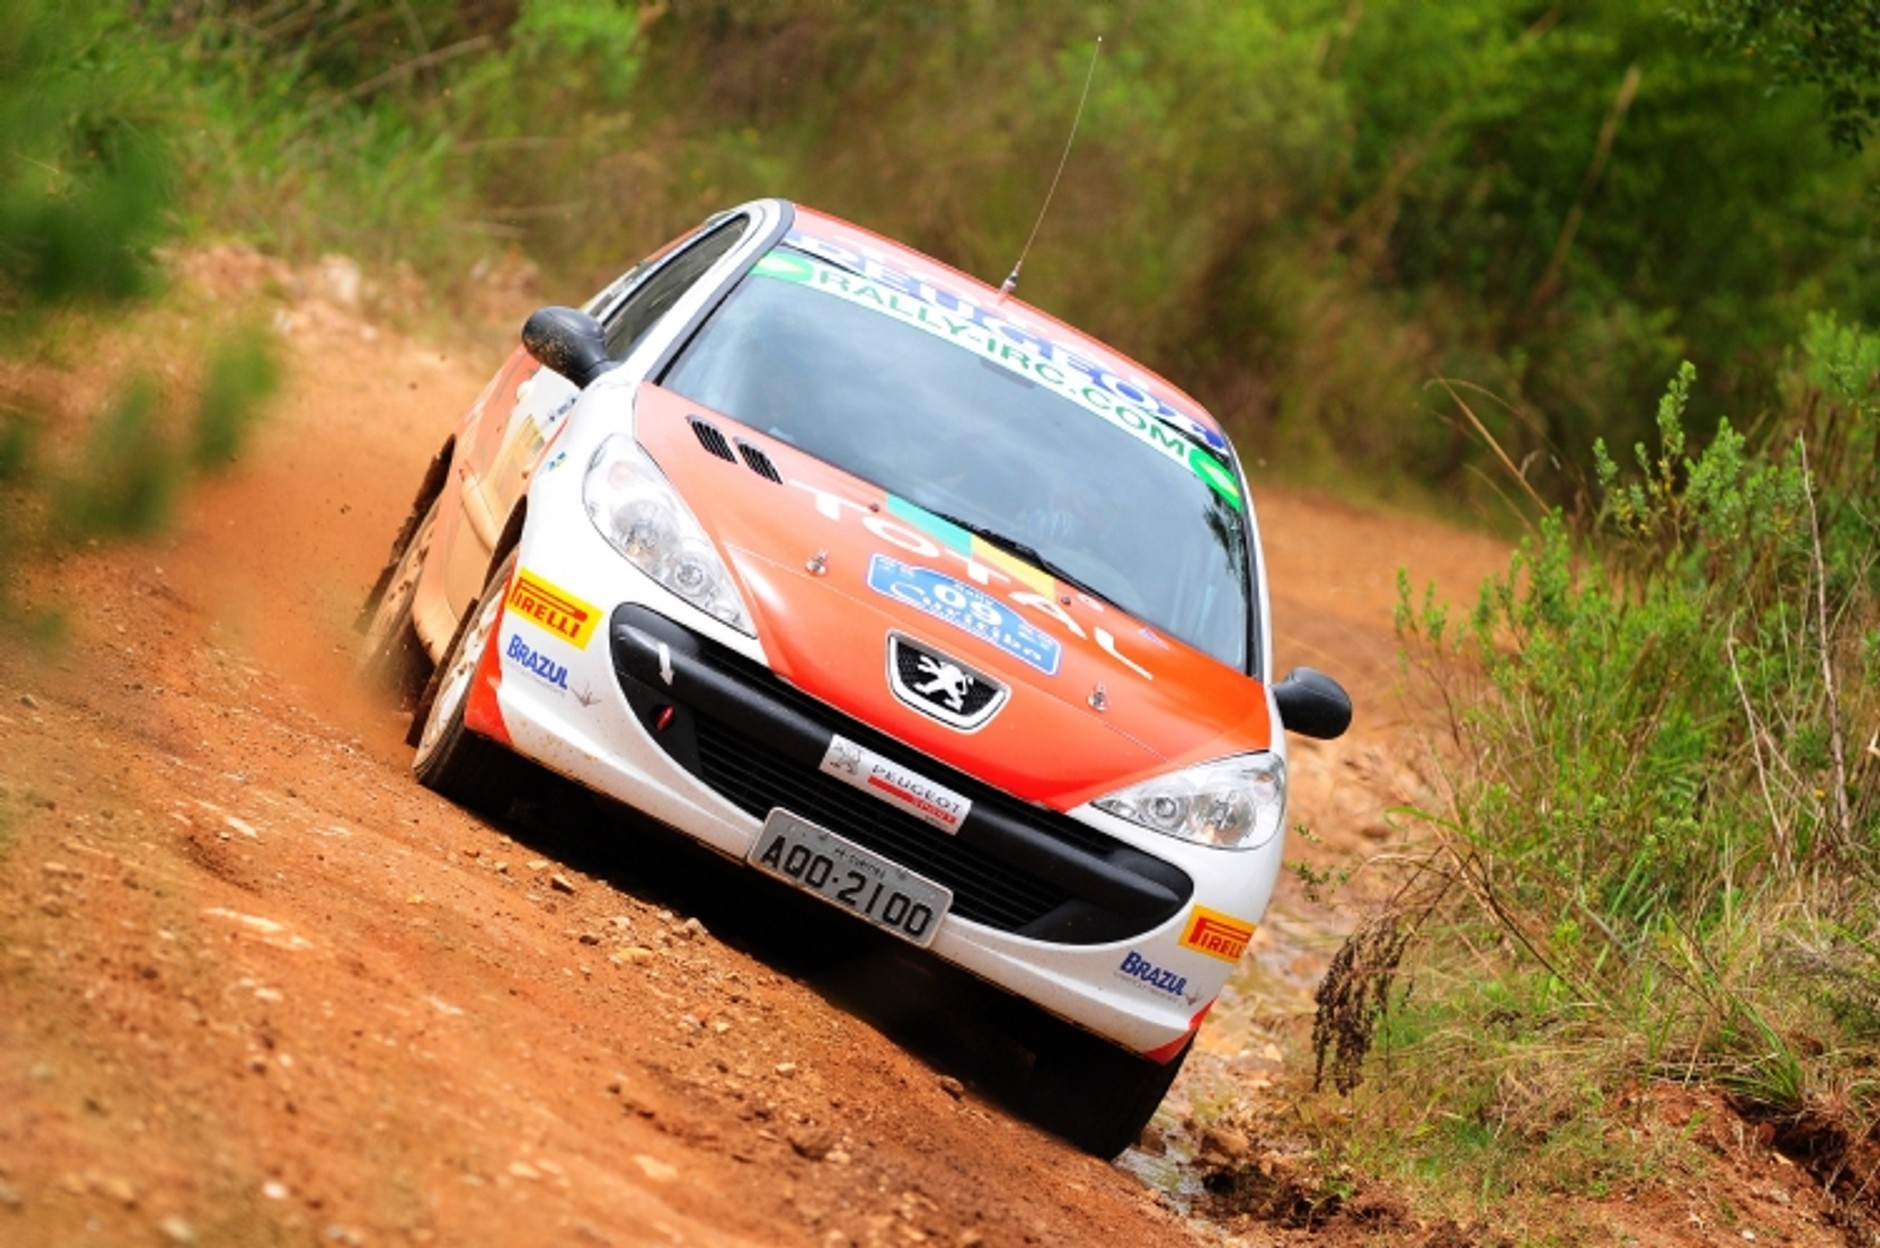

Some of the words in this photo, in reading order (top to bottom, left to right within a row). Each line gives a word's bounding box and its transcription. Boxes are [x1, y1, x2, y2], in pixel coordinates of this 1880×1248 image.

[800, 234, 1208, 442] PEUGEOT
[819, 270, 1185, 457] RALLY-IRC.COM
[508, 577, 588, 639] PIRELLI
[788, 479, 1153, 680] TOTAL
[933, 583, 1003, 626] 09
[506, 633, 568, 690] BRAZUL
[872, 763, 963, 815] PEUGEOT
[1120, 950, 1187, 996] BRAZUL
